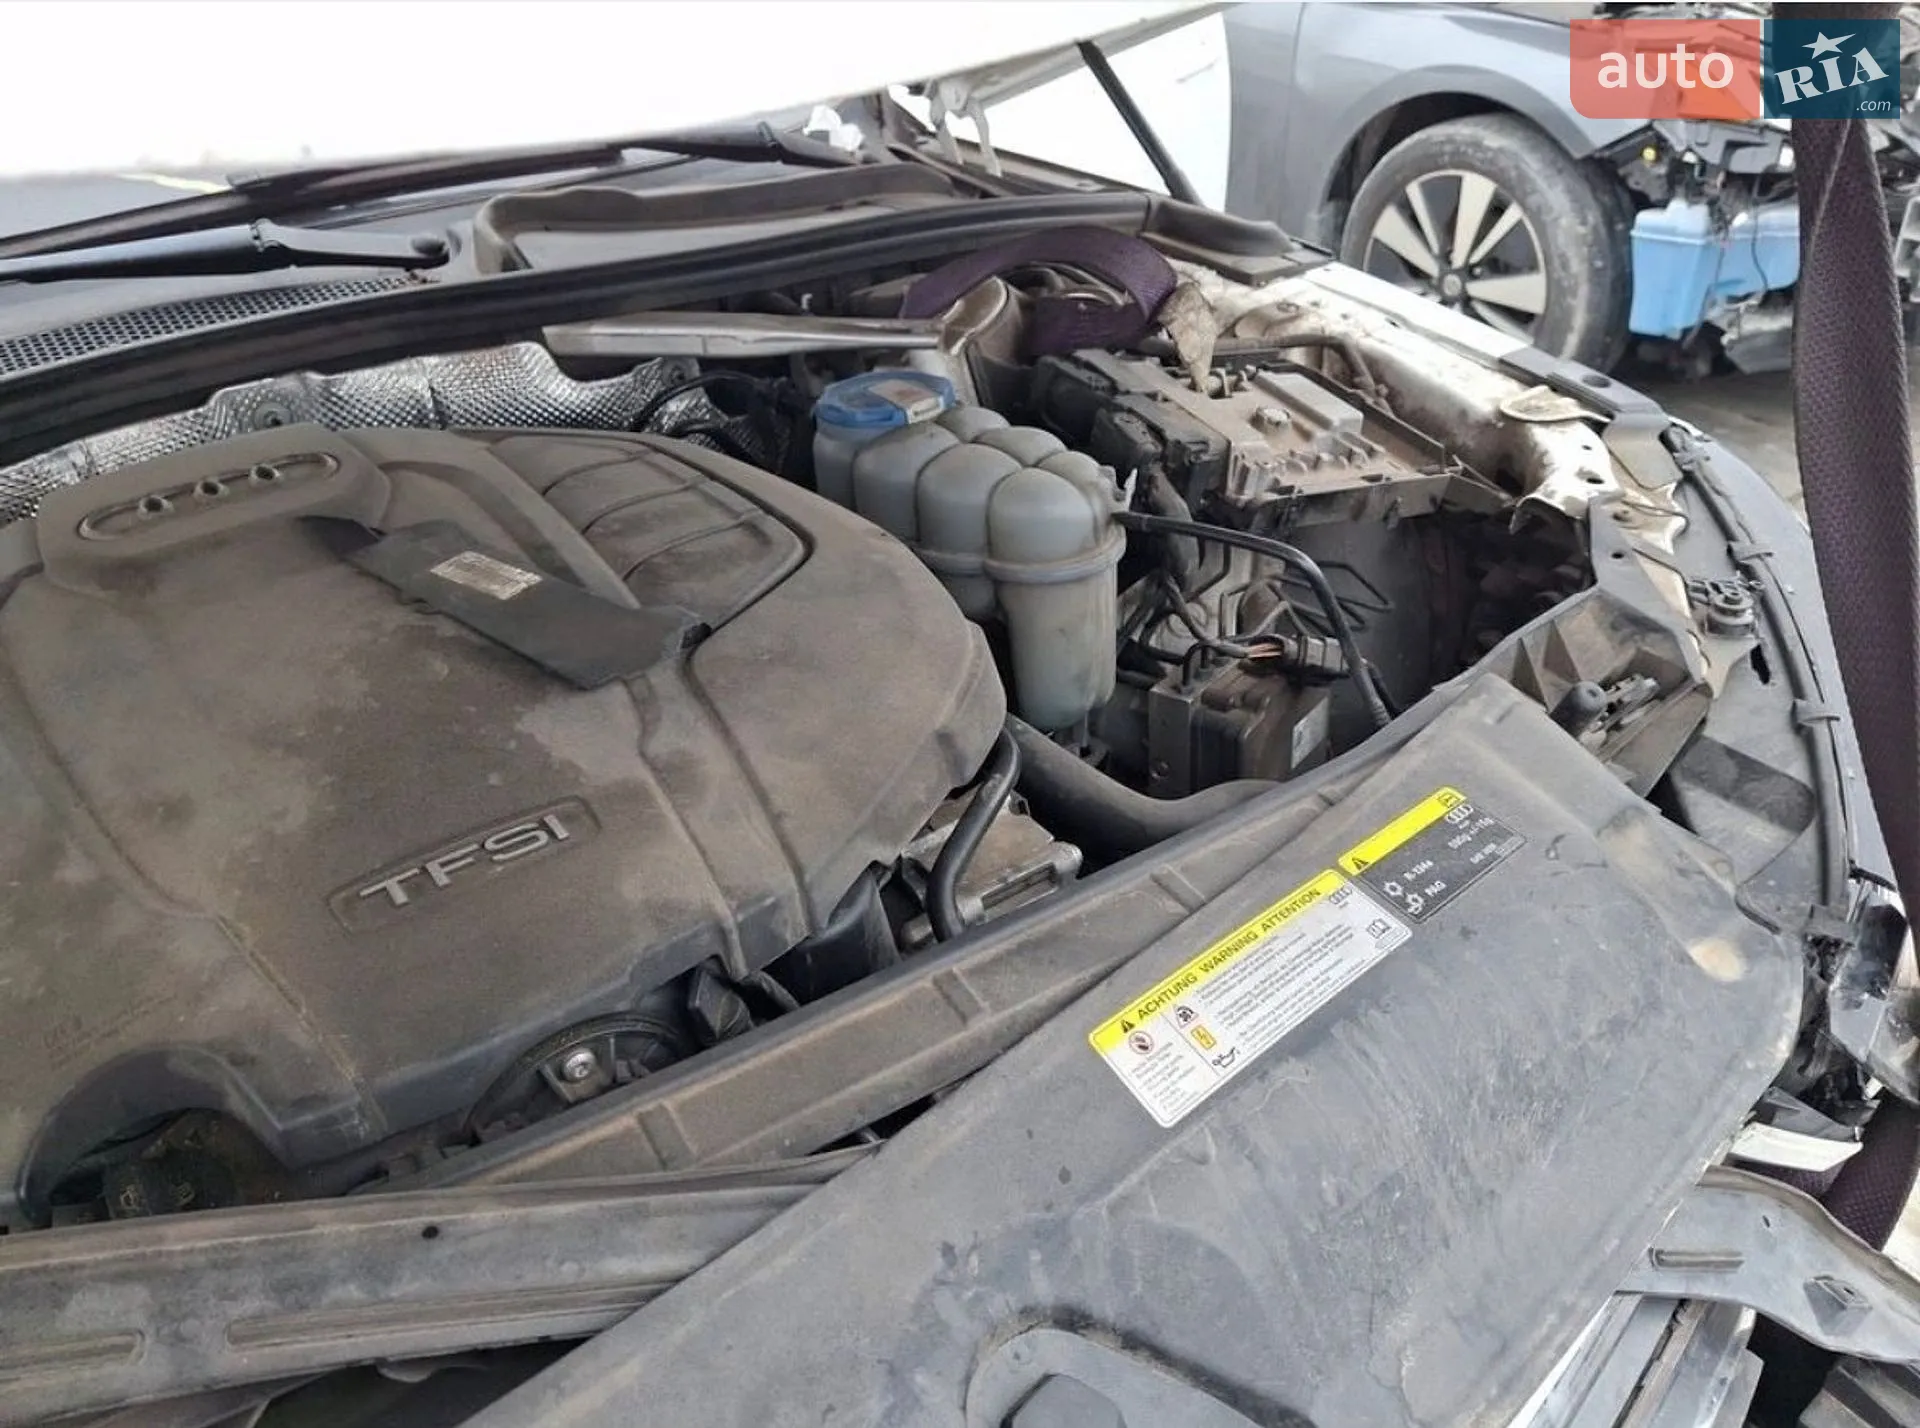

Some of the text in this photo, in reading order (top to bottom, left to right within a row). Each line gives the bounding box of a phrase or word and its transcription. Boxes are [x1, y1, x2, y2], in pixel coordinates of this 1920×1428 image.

[359, 814, 570, 906] TFSI
[1138, 972, 1198, 1020] ACHTUNG
[1200, 931, 1259, 973] WARNING
[1261, 888, 1321, 932] ATTENTION
